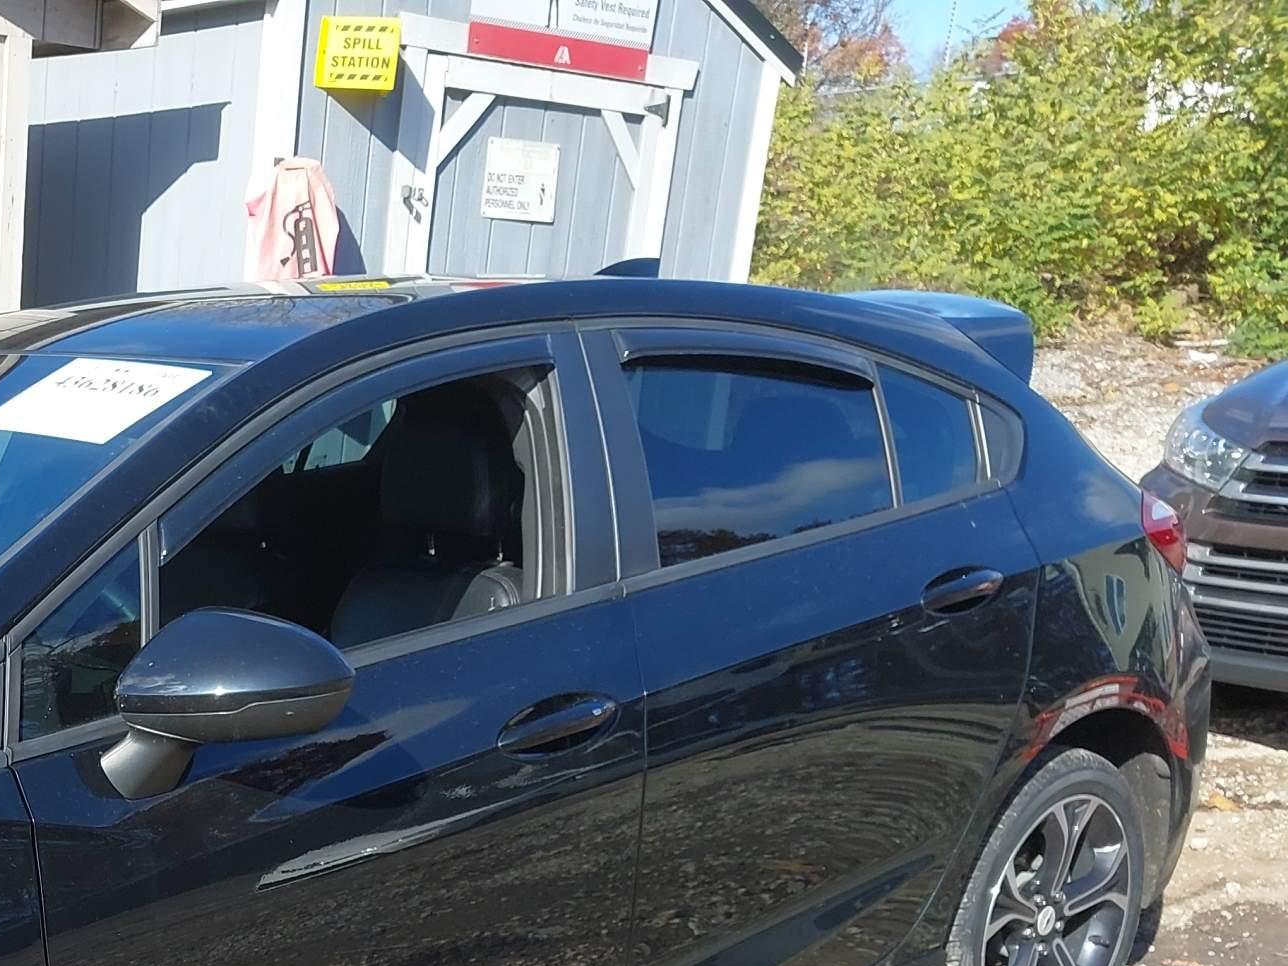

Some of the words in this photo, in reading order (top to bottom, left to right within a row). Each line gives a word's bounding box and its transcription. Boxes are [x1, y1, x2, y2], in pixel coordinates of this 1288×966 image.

[600, 0, 617, 12] Vest
[618, 1, 650, 19] Required
[343, 37, 383, 50] SPILL
[330, 56, 390, 69] STATION
